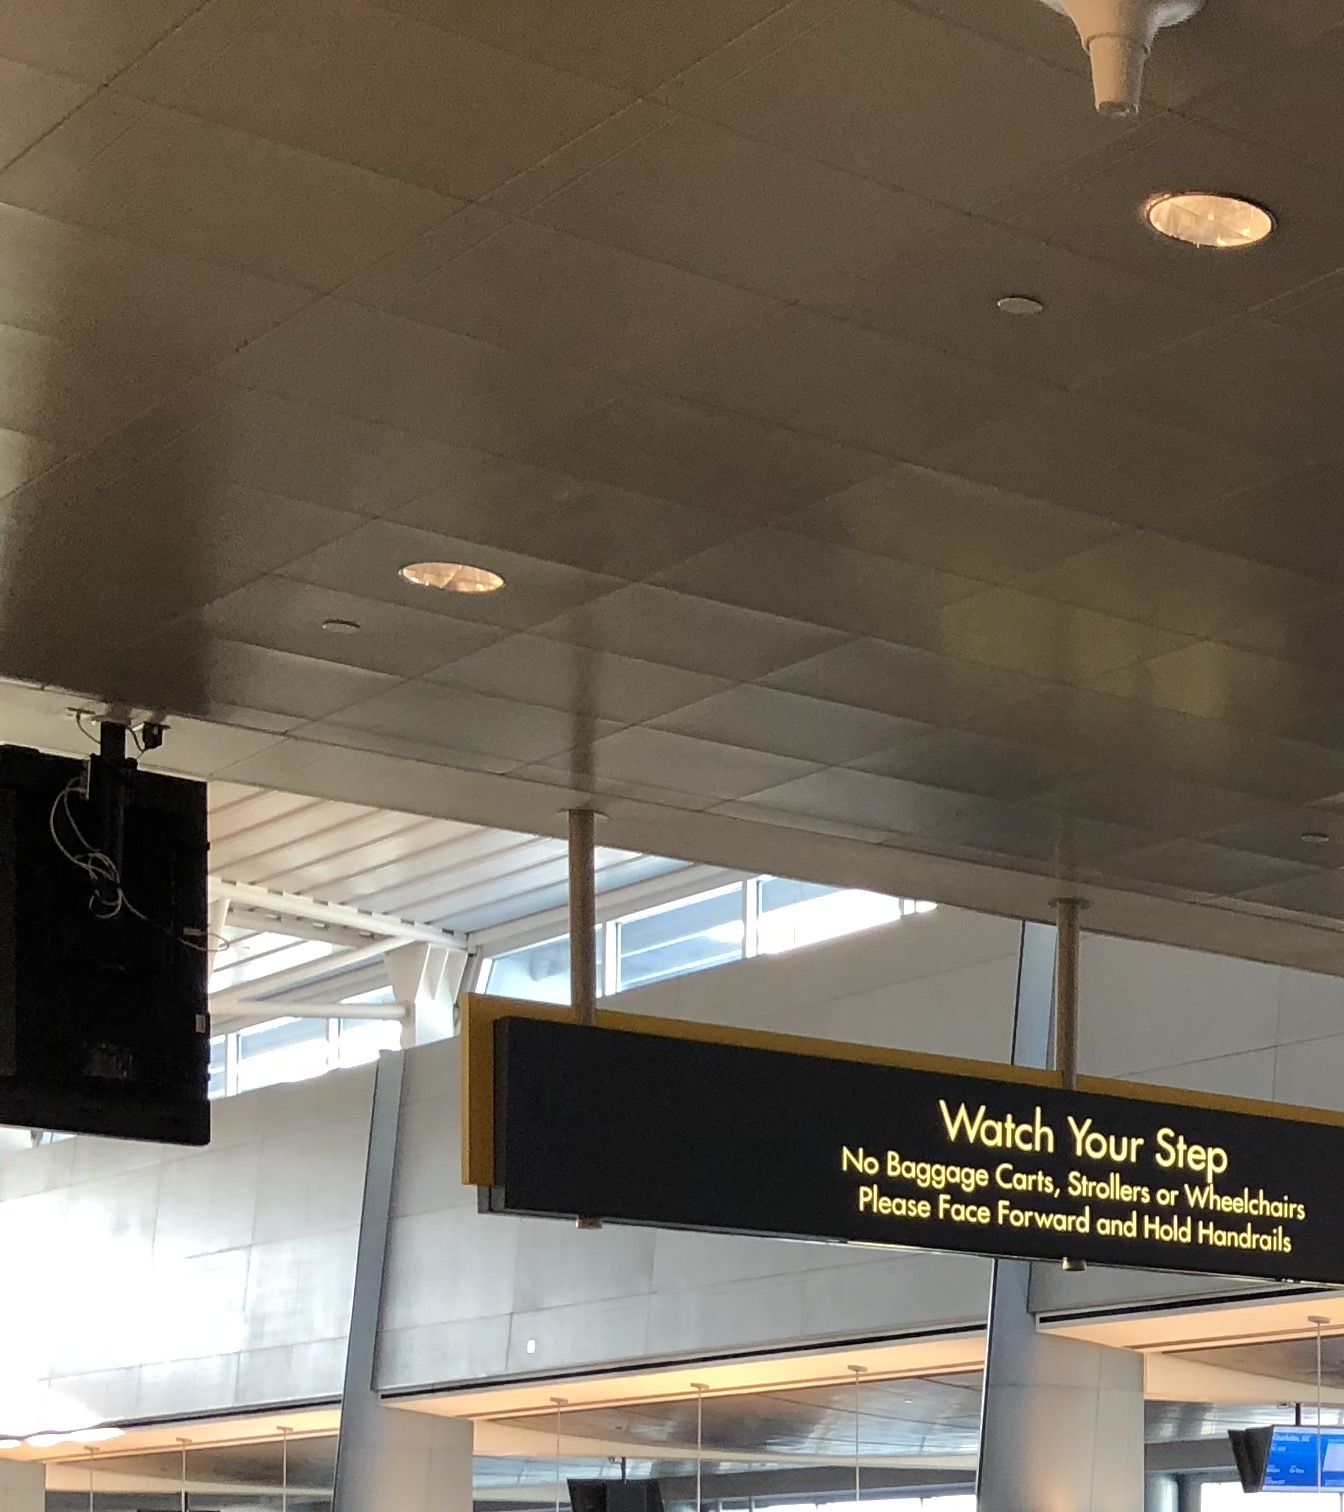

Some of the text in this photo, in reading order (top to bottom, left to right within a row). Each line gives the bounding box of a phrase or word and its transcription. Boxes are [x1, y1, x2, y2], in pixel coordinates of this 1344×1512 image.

[938, 1099, 1229, 1183] Watch Your Step
[841, 1145, 1306, 1221] No Baggage Carts, Strollers or Wheelchairs
[858, 1183, 1292, 1254] Please Face Forward and Hold Handrails
